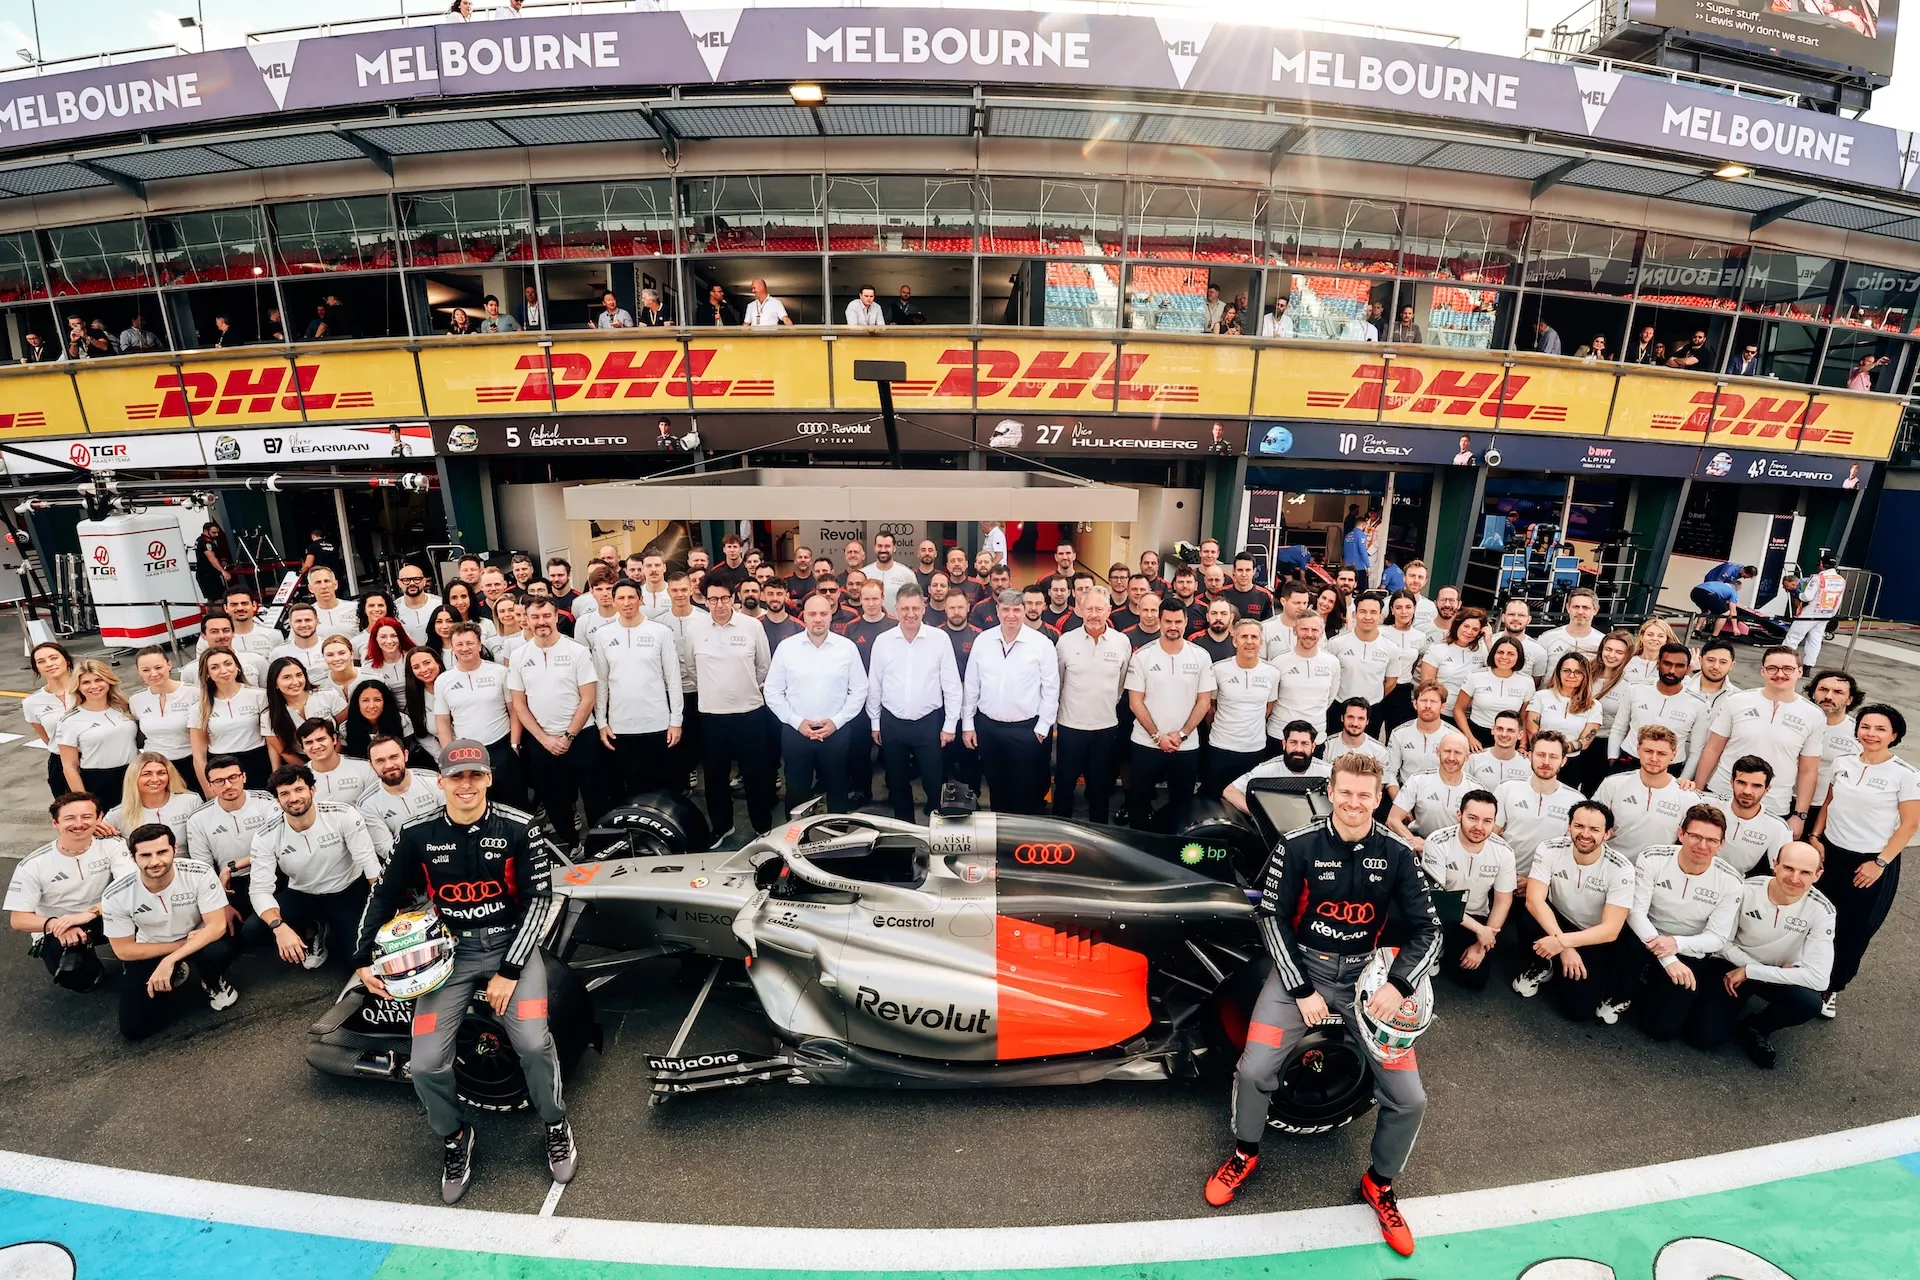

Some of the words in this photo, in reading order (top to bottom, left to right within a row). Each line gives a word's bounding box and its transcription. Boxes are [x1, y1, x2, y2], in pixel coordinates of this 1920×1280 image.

[1707, 2, 1735, 17] Super
[1737, 10, 1761, 22] stuff.
[1705, 14, 1733, 27] Lewis
[1735, 21, 1755, 34] why
[1757, 25, 1780, 38] don't
[1782, 32, 1796, 41] we
[1797, 35, 1819, 46] start
[693, 31, 730, 48] MEL
[806, 26, 1090, 69] MELBOURNE
[1164, 40, 1200, 56] MEL
[355, 31, 620, 88] MELBOURNE
[258, 63, 291, 79] MEL
[1273, 47, 1520, 110] MELBOURNE
[0, 72, 201, 132] MELBOURNE
[1579, 88, 1608, 107] MEL
[1662, 102, 1854, 166] MELBOURNE
[515, 350, 733, 402] DHL
[933, 350, 1161, 401] DHL
[155, 364, 337, 418] DHL
[1344, 364, 1535, 418] DHL
[1681, 391, 1829, 442] DHL
[506, 427, 520, 447] 5
[529, 424, 560, 440] Gabriel
[832, 424, 871, 434] Revolut
[1036, 426, 1063, 444] 27
[1072, 422, 1092, 438] Nico
[264, 438, 283, 454] 87
[292, 444, 369, 454] BEARMAN
[531, 436, 627, 447] BORTOLETO
[1072, 439, 1198, 450] HULKENBERG
[1340, 434, 1357, 455] 10
[90, 445, 127, 456] TGR
[1363, 447, 1413, 455] GASLY
[1748, 459, 1765, 478] 43
[1768, 469, 1832, 481] COLAPINTO
[90, 566, 116, 576] TGR
[144, 559, 177, 572] TGR
[614, 816, 622, 824] P
[627, 815, 675, 837] ZERO
[944, 834, 971, 843] visit
[933, 844, 971, 852] QATAR
[1207, 846, 1226, 861] bp
[1315, 860, 1342, 869] Revolut
[806, 876, 826, 886] WORLD
[172, 900, 197, 908] Revolut
[686, 912, 732, 925] NEXO
[768, 919, 800, 930] CAMOZZI
[887, 917, 935, 928] Castrol
[389, 936, 419, 950] Revolut
[856, 986, 990, 1034] Revolut
[1390, 1018, 1420, 1028] Revolut
[650, 1053, 738, 1071] ninjaOne
